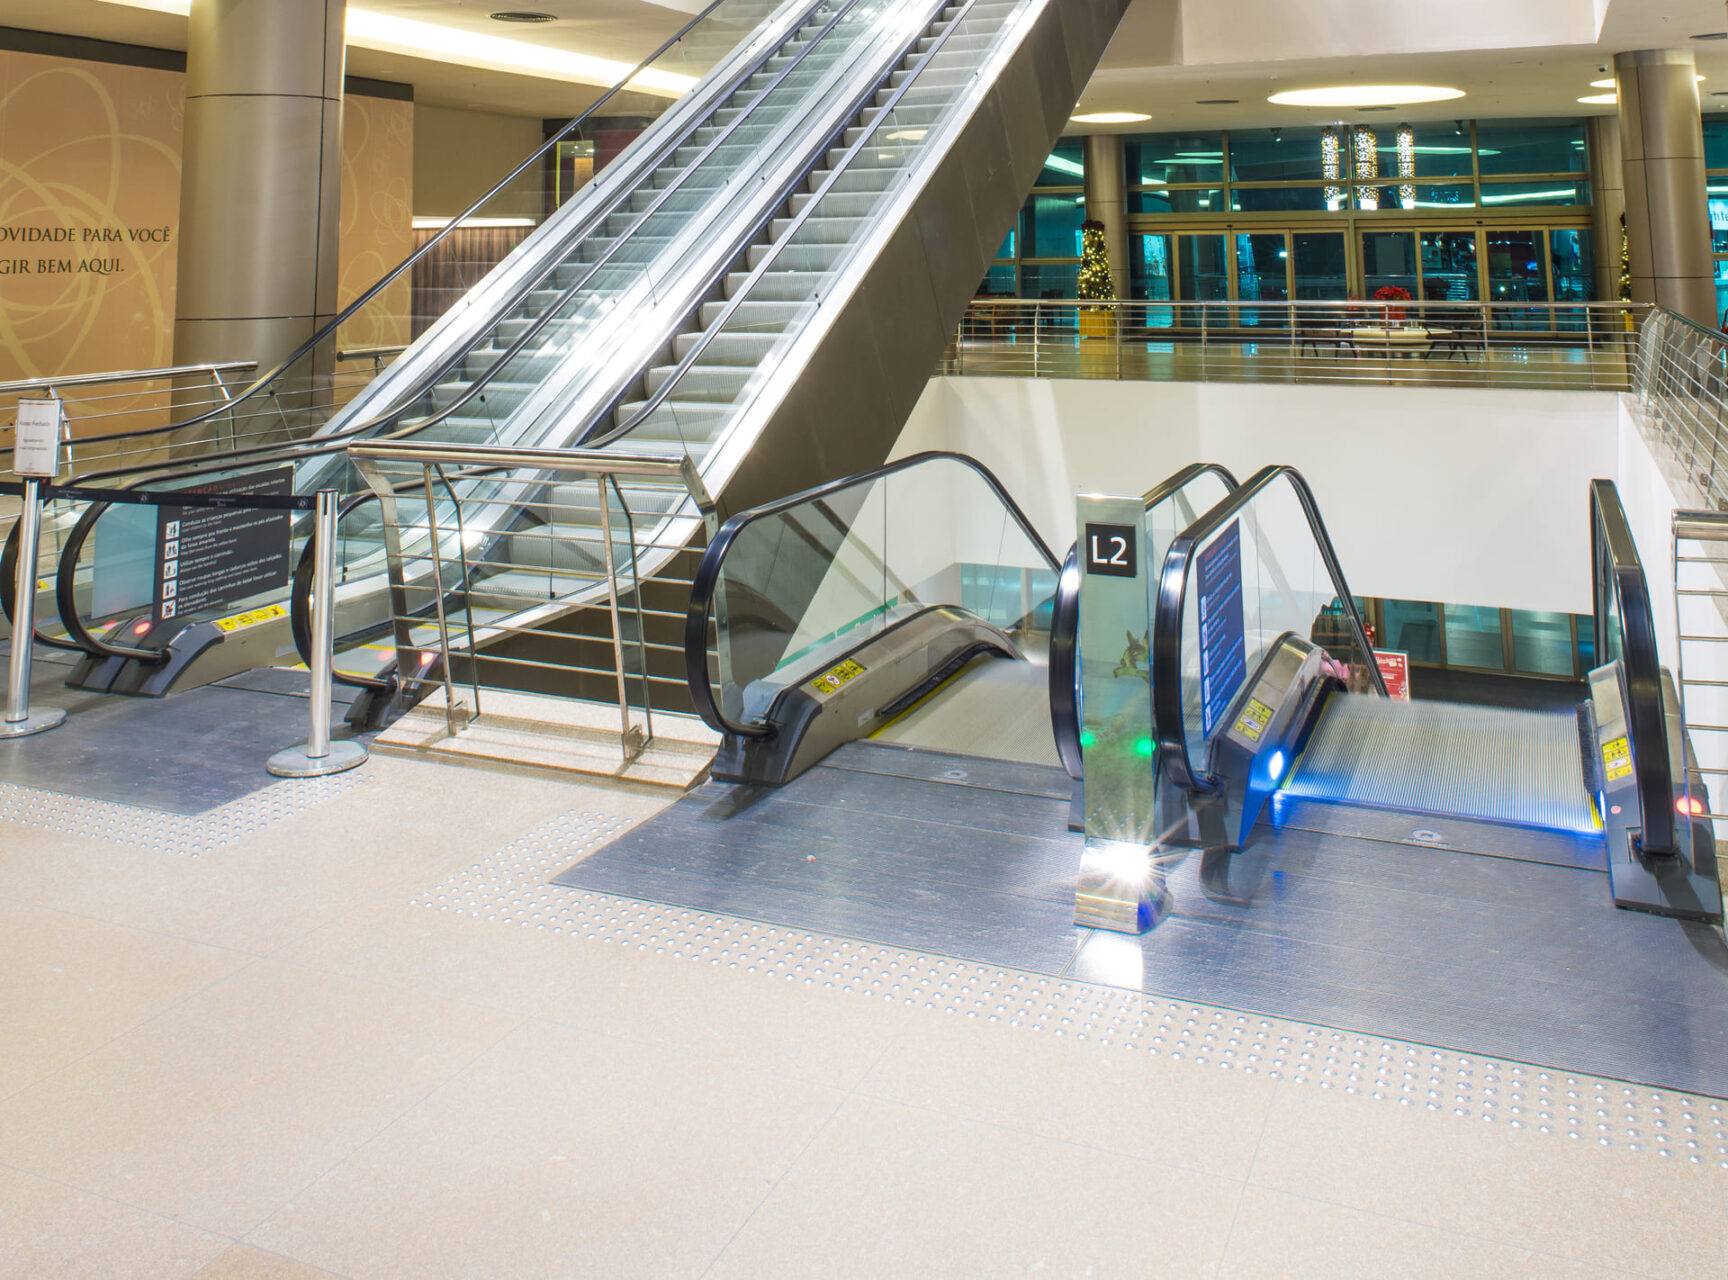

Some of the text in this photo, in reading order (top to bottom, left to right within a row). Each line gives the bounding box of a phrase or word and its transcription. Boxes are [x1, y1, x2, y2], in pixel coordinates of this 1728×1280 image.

[82, 227, 123, 242] PARA
[128, 226, 170, 242] VOCÊ
[0, 258, 125, 276] GIR BEM AQUI.
[1091, 535, 1128, 566] L2
